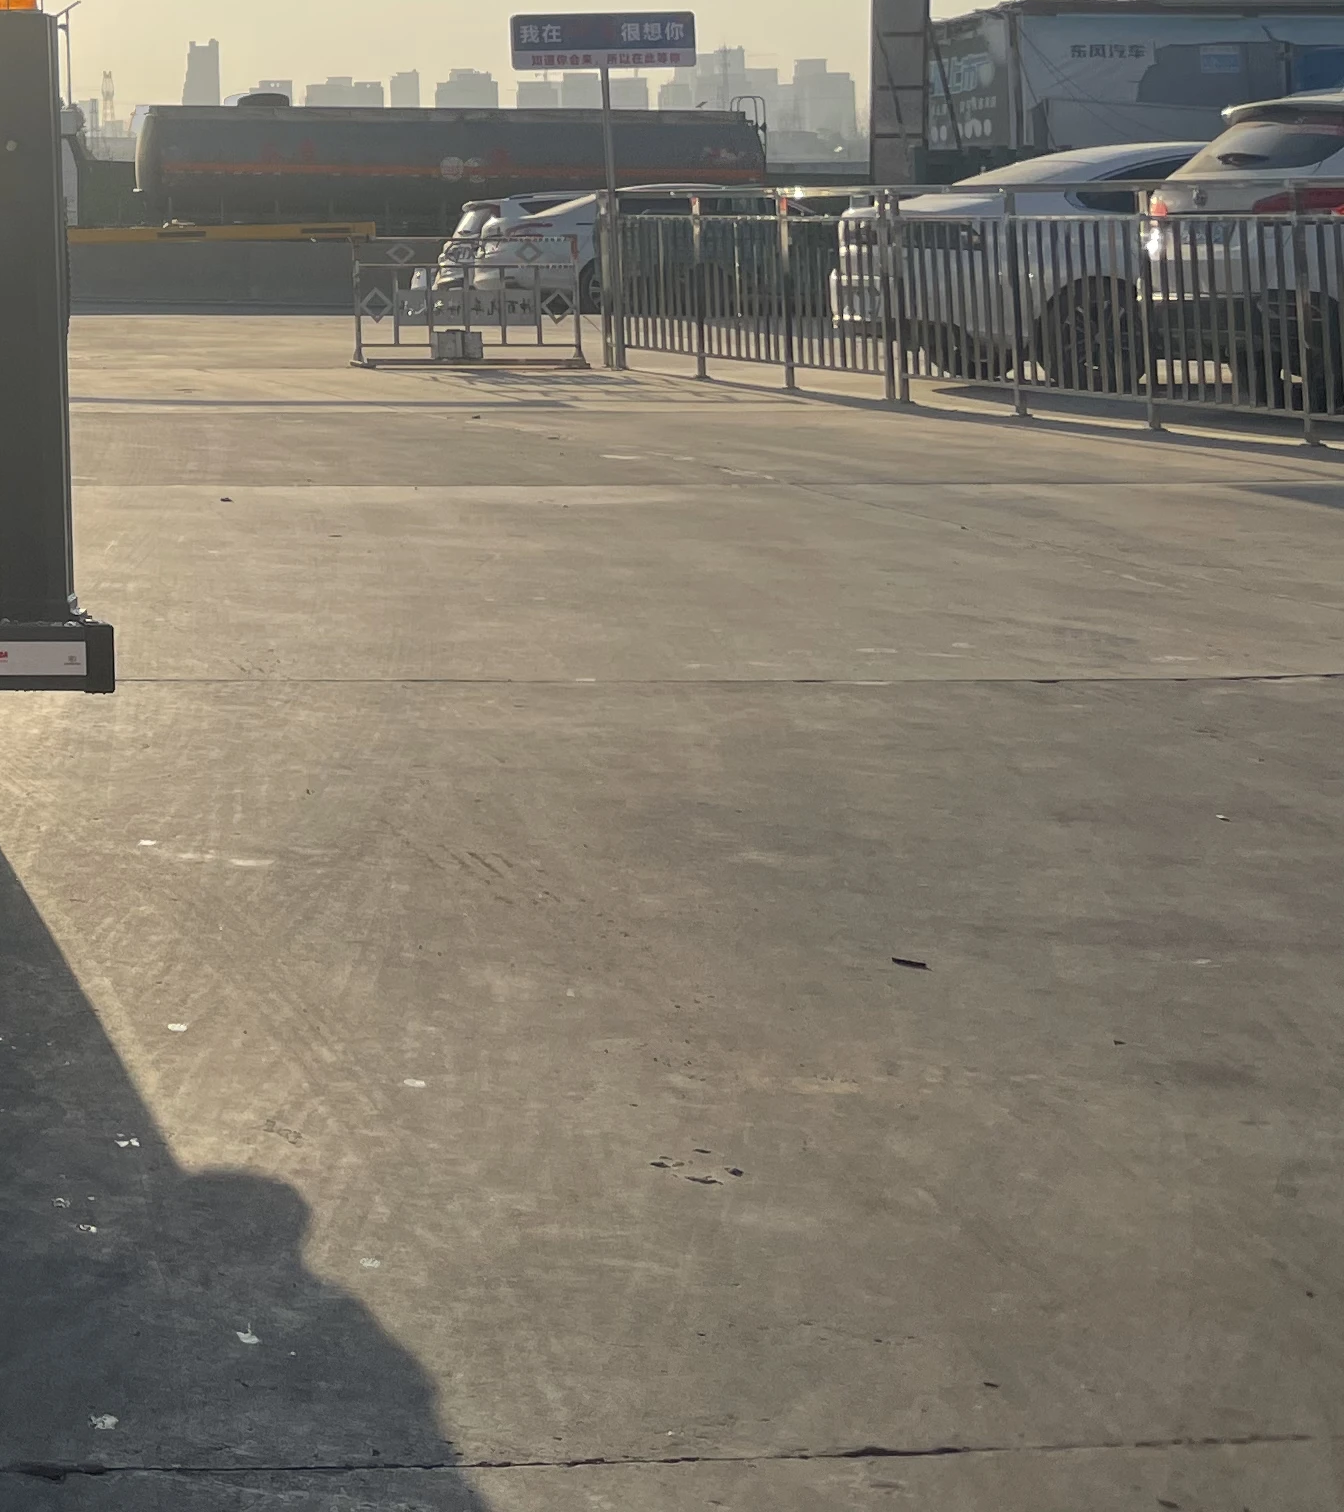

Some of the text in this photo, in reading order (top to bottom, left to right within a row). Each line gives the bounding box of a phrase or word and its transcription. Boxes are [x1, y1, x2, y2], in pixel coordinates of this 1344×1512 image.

[520, 24, 562, 44] 我在
[621, 21, 685, 42] 很想你
